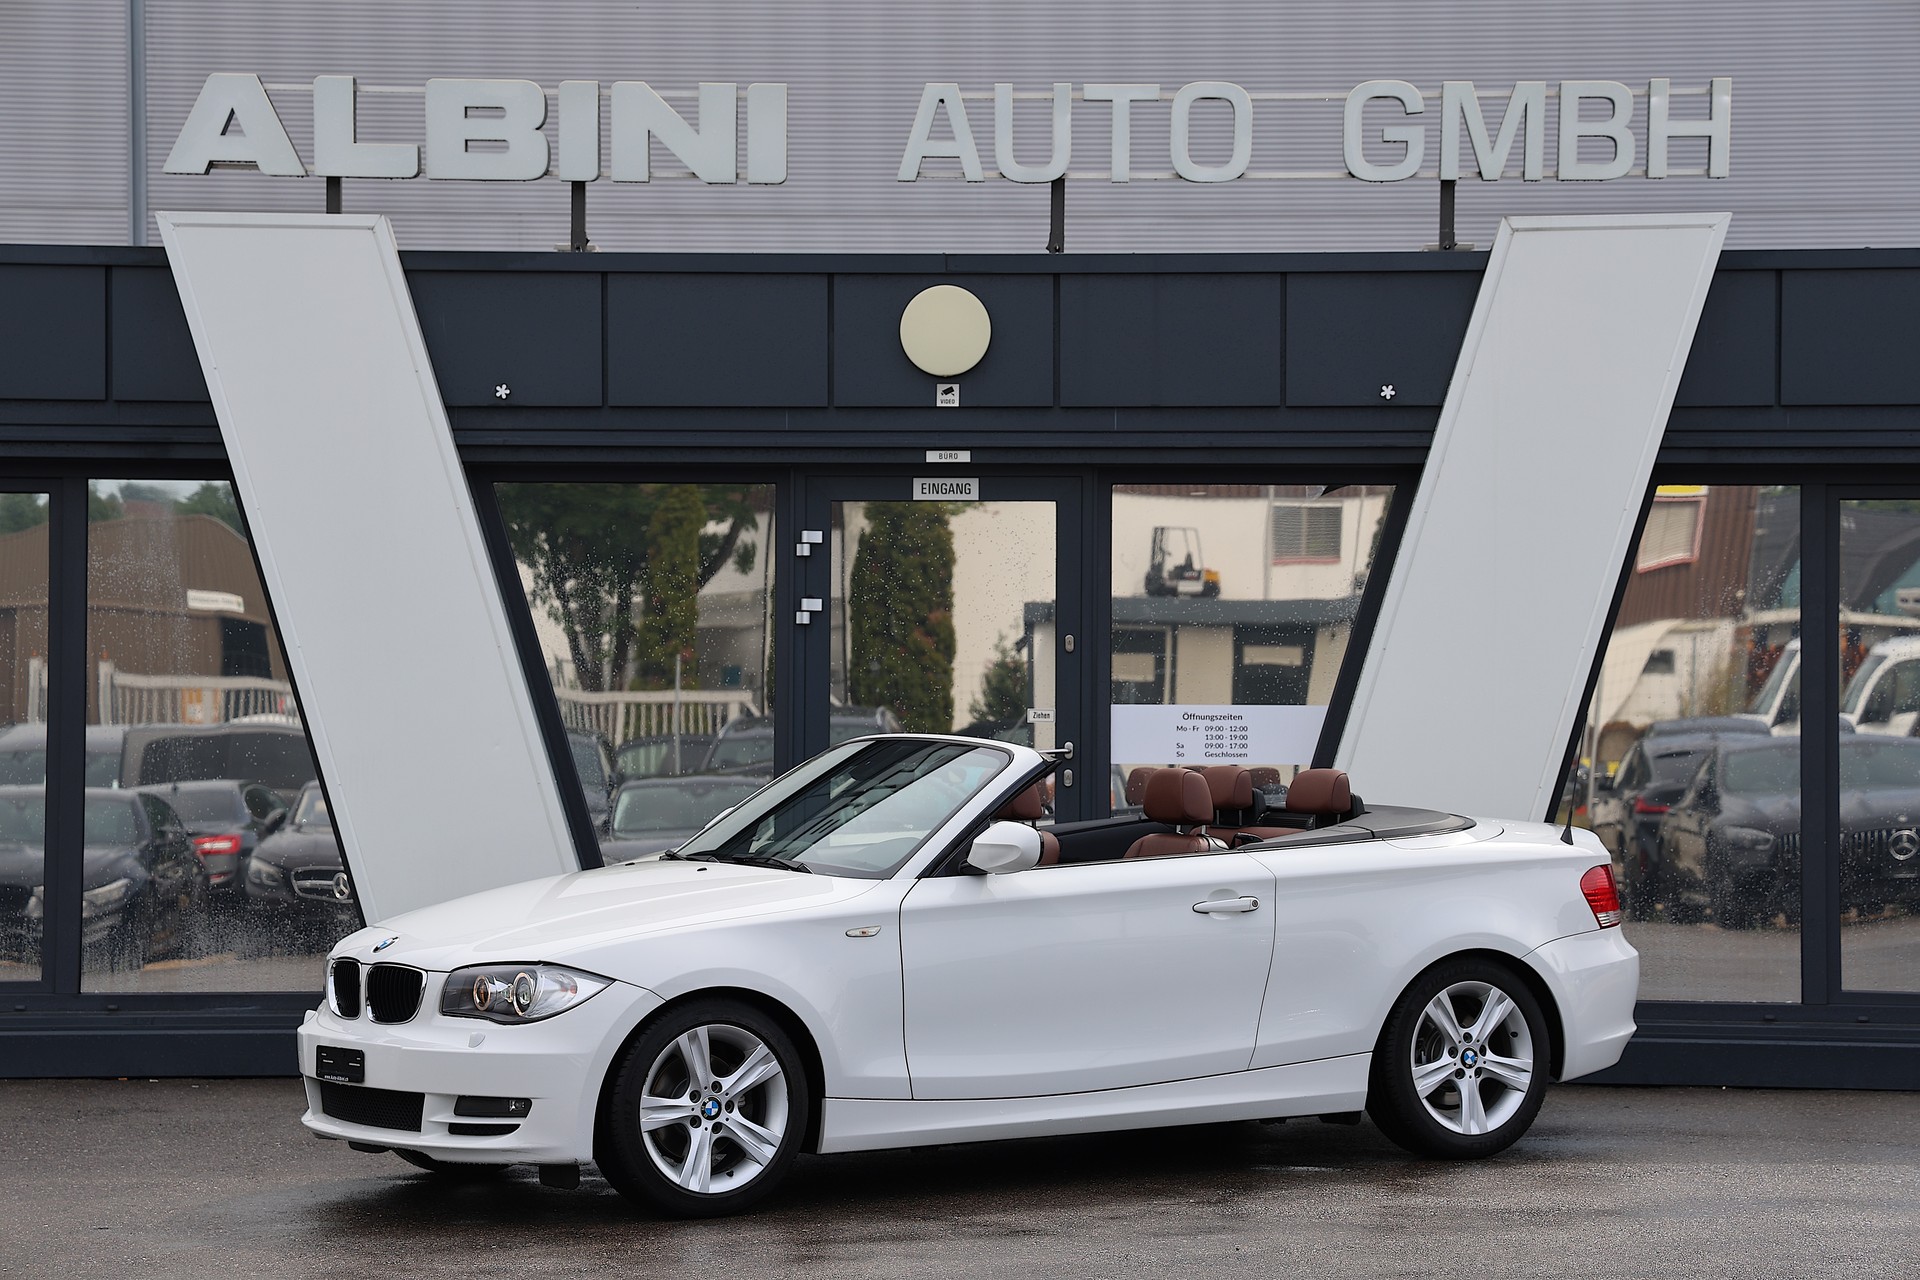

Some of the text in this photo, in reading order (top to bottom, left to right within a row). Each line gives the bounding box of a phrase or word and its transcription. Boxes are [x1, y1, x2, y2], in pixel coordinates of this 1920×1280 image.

[163, 73, 1733, 185] ALBINI AUTO GMBH
[938, 451, 959, 460] BÜRO
[920, 482, 972, 495] EINGANG
[1032, 711, 1051, 719] Ziehen
[1182, 712, 1243, 722] Öffnungszeiten
